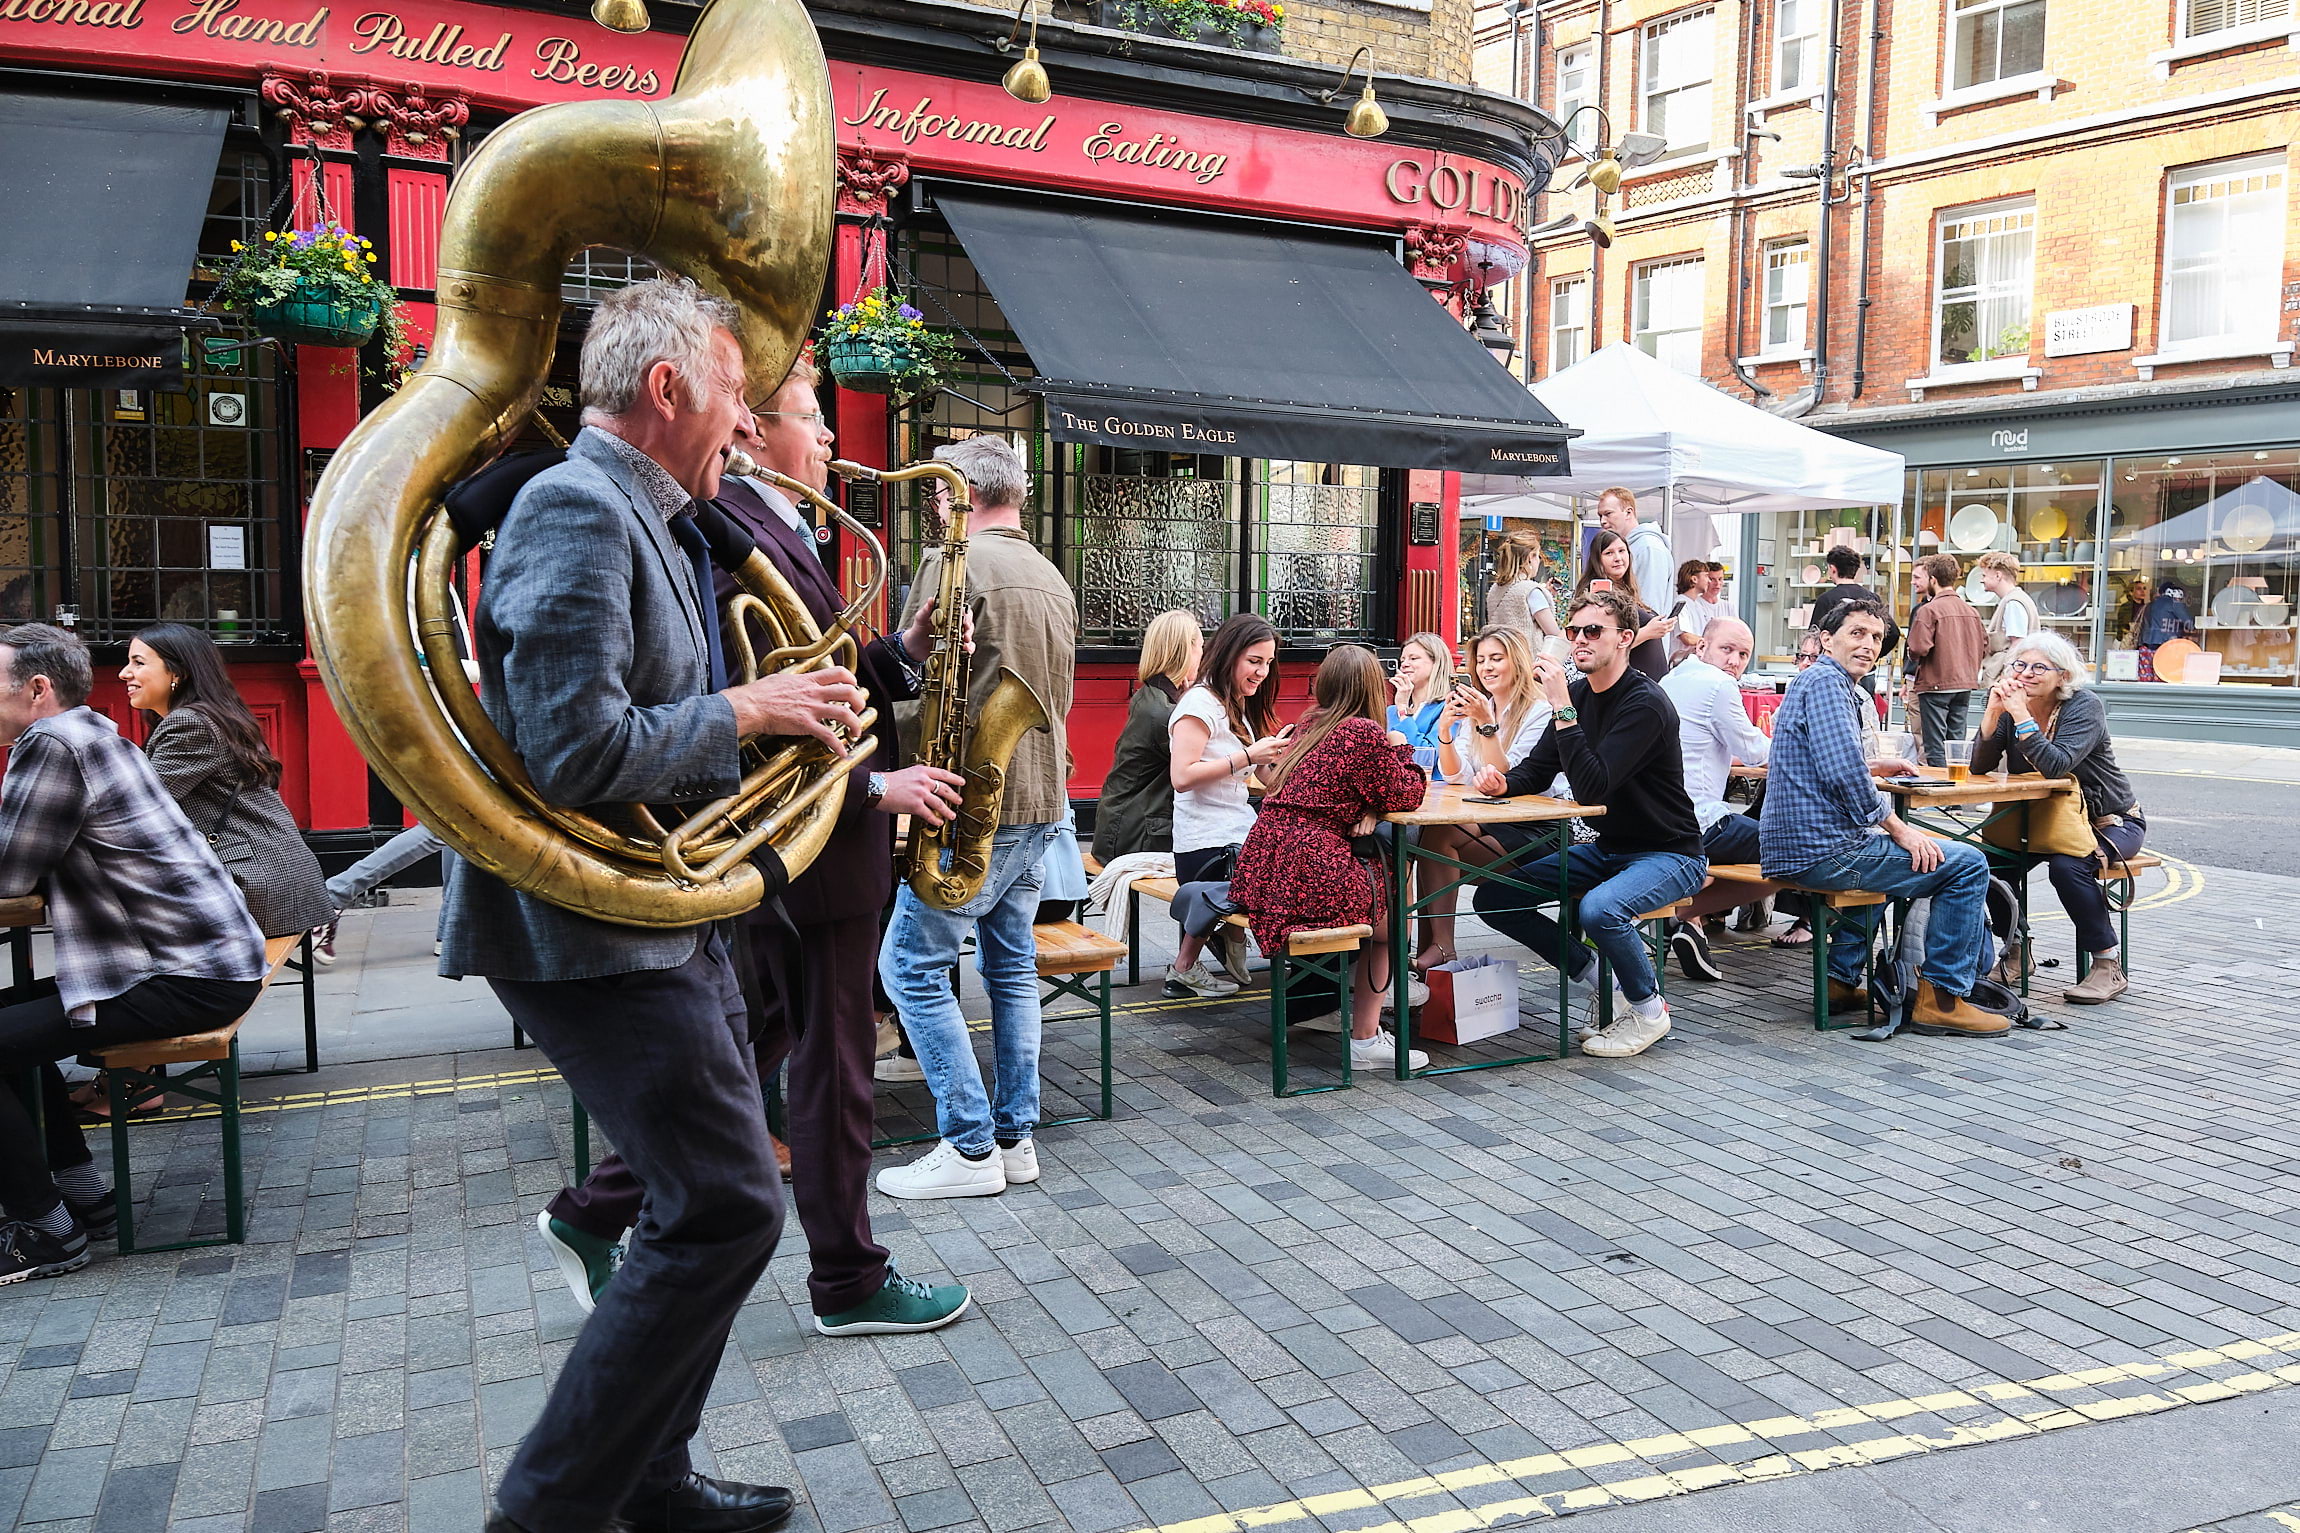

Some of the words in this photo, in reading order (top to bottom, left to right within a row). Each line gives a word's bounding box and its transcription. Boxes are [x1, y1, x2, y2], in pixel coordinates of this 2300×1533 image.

[170, 0, 331, 48] Hand
[349, 11, 513, 71] Pulled
[530, 37, 661, 96] Beers
[843, 87, 1057, 152] Informal
[1082, 122, 1229, 184] Eating
[2053, 326, 2095, 342] STREET
[32, 348, 163, 369] MARYLEBONE
[1061, 412, 1098, 433] THE
[1104, 416, 1175, 439] GOLDEN
[1181, 422, 1237, 443] EAGLE
[1991, 428, 2029, 447] mud
[1490, 448, 1559, 463] MARYLEBONE
[1474, 994, 1495, 1005] swatch
